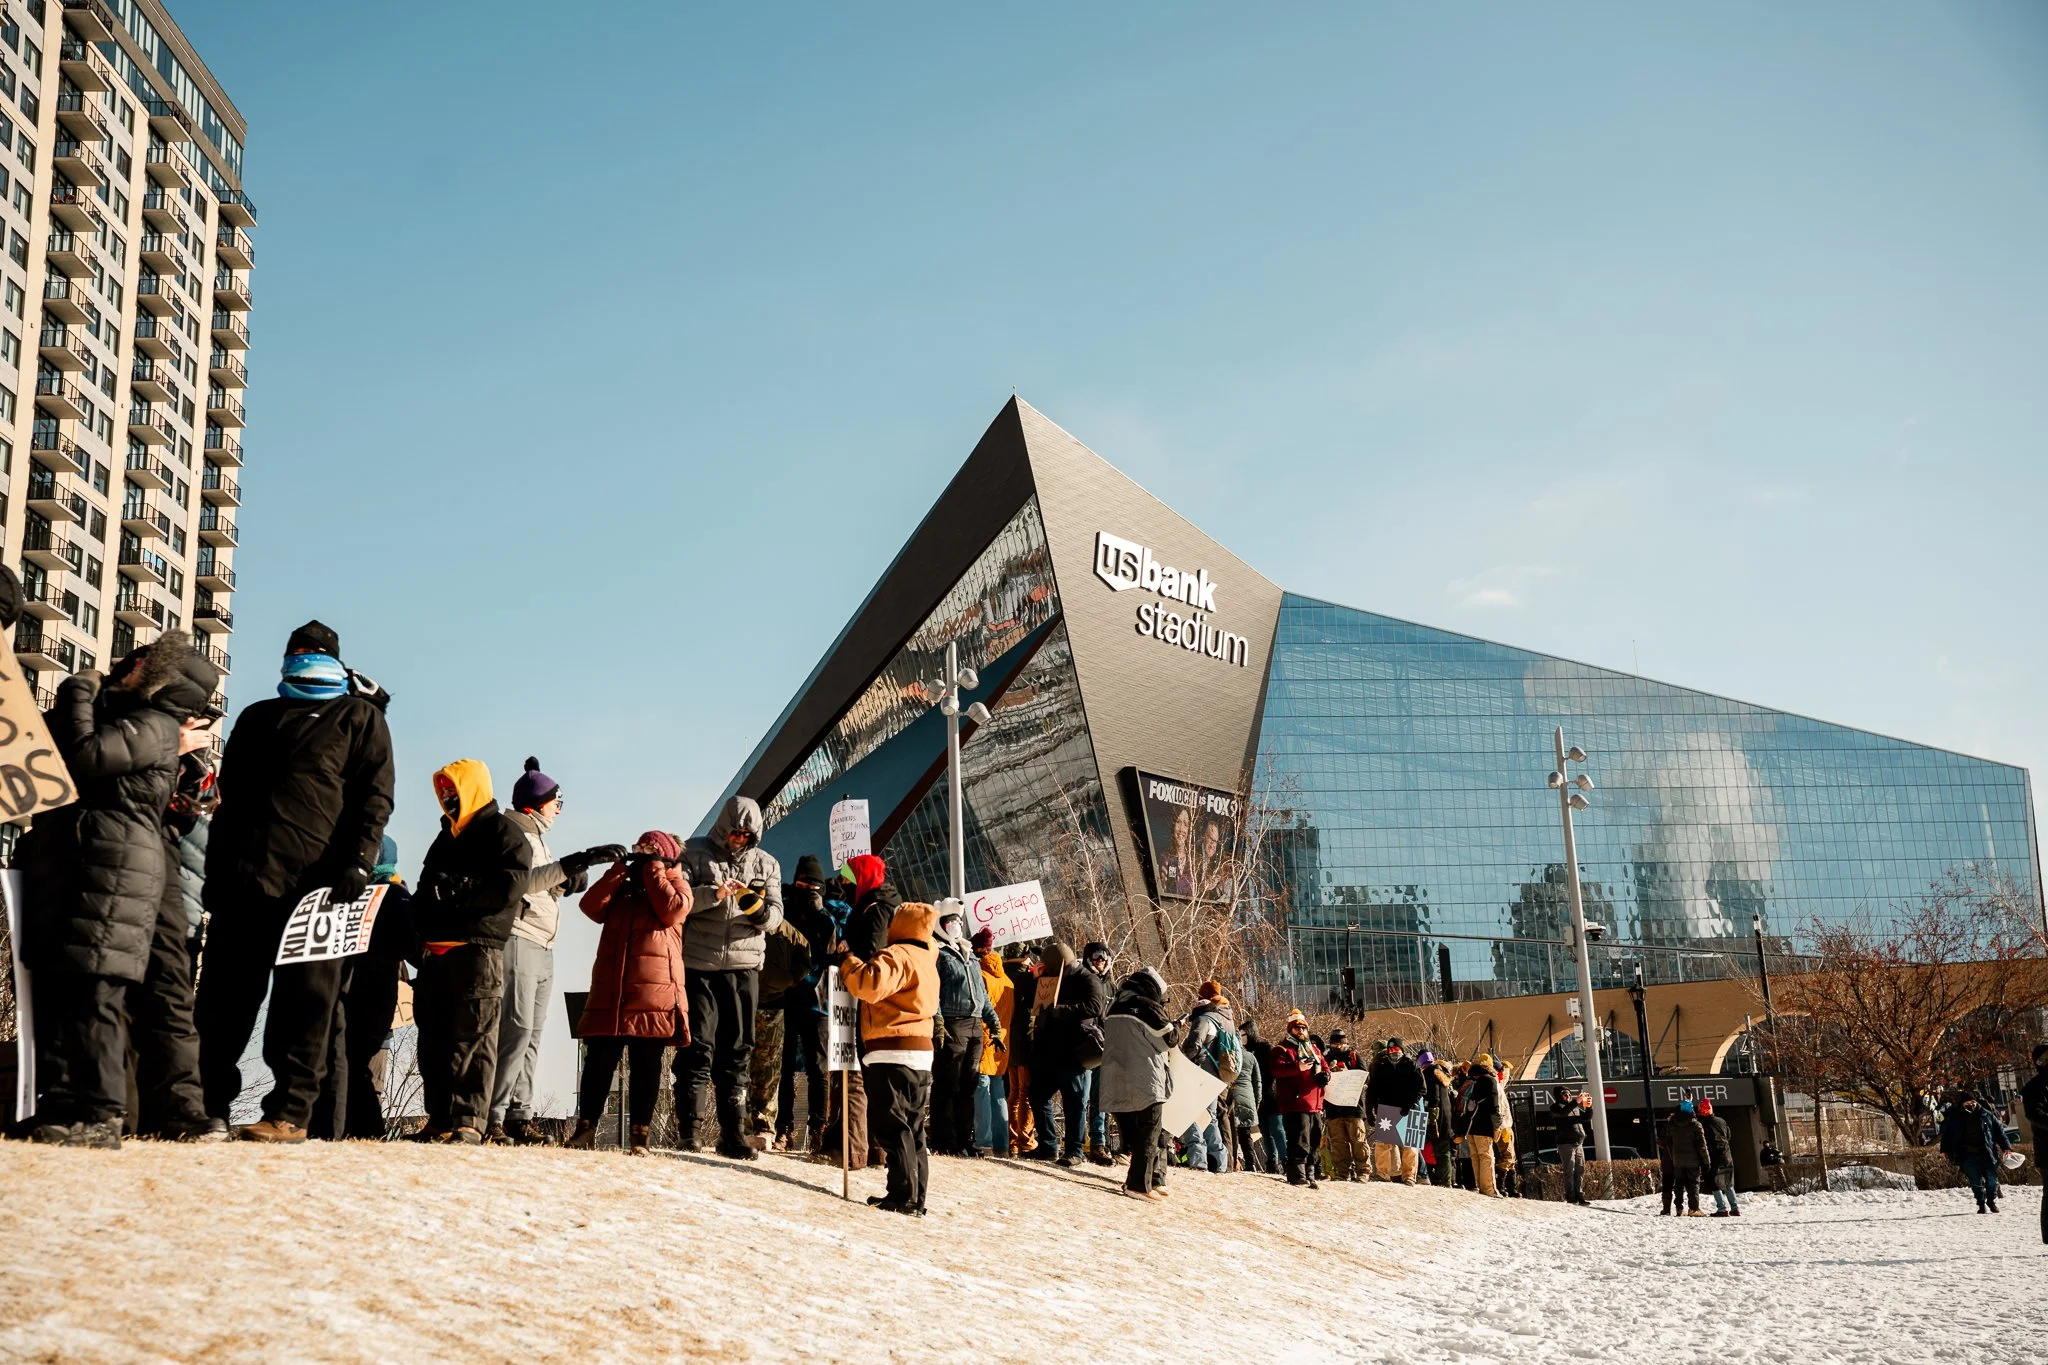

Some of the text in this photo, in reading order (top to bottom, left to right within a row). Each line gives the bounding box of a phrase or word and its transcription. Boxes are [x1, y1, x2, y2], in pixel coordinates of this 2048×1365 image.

[1135, 601, 1249, 668] stadium
[1207, 794, 1230, 817] FOX
[973, 893, 1039, 923] Gestapo
[280, 892, 321, 960] KILLER
[1667, 1085, 1729, 1101] ENTER
[1407, 1110, 1427, 1130] ICE
[1404, 1128, 1425, 1149] OUT
